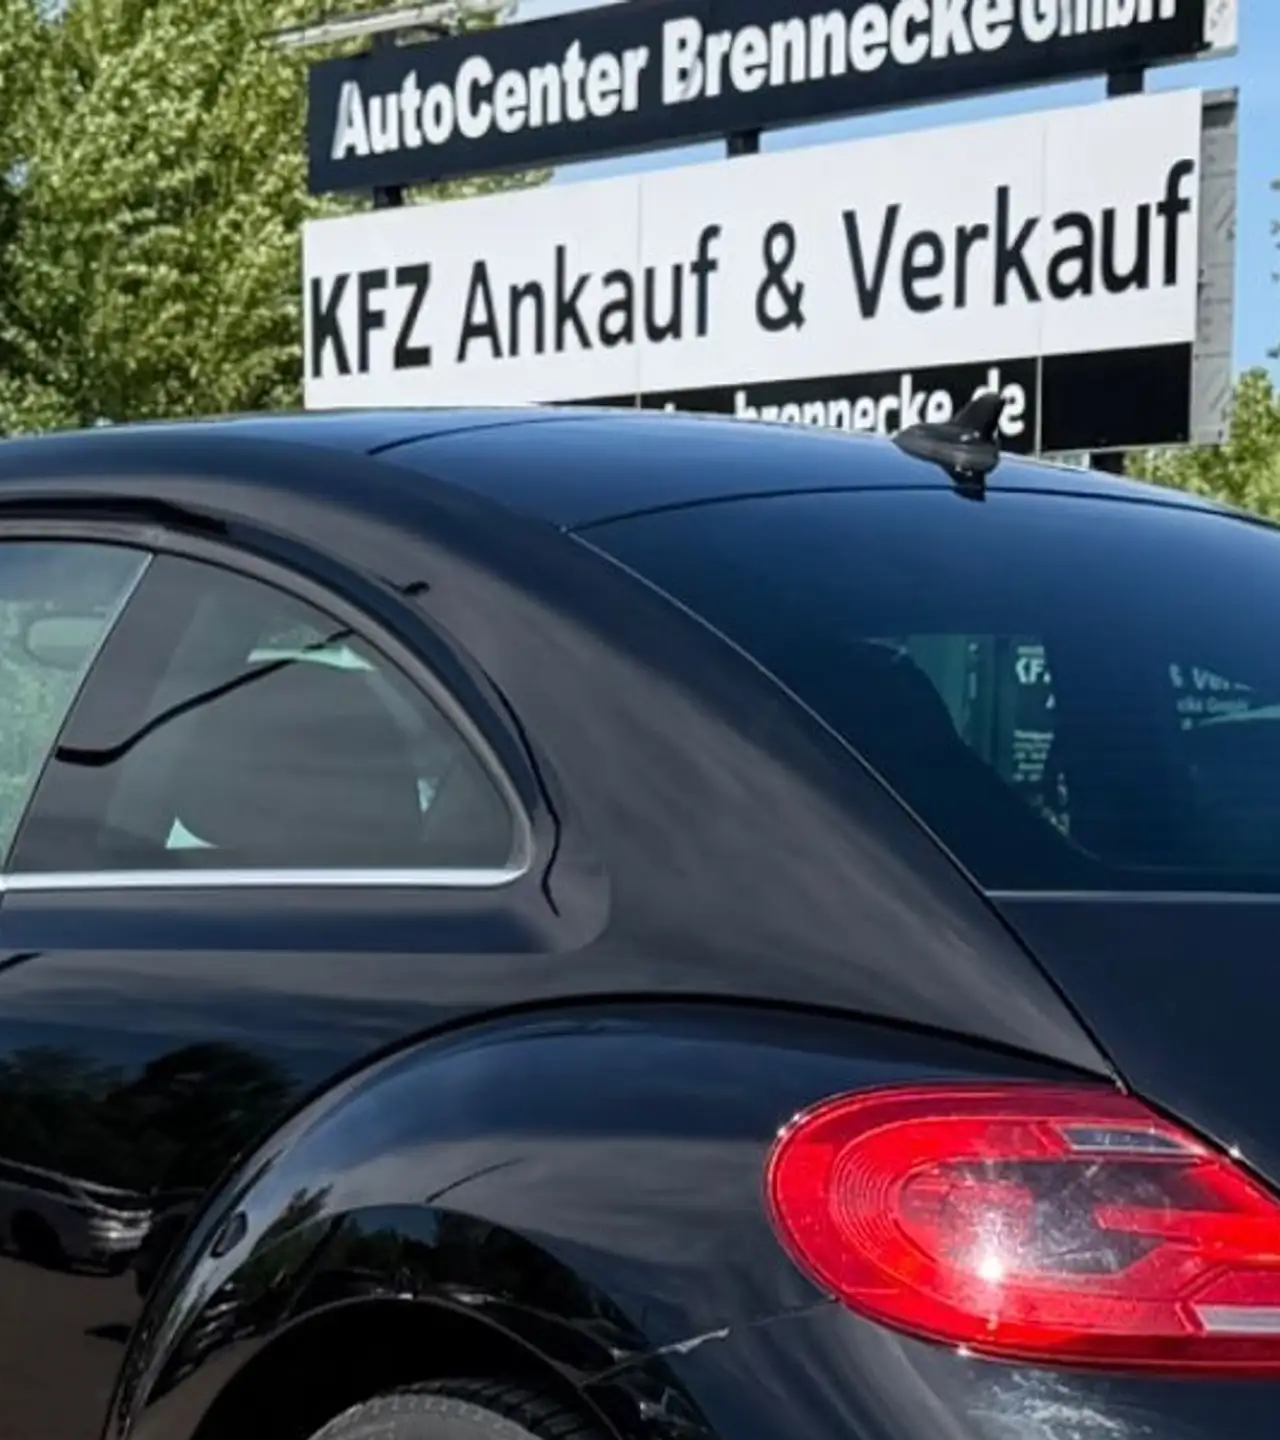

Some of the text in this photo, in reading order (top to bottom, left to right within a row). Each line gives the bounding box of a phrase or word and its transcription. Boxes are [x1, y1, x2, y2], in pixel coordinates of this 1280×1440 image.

[331, 0, 1177, 161] AutoCenter Brennecke Gm
[311, 158, 1195, 379] KFZ Ankauf & Verkauf
